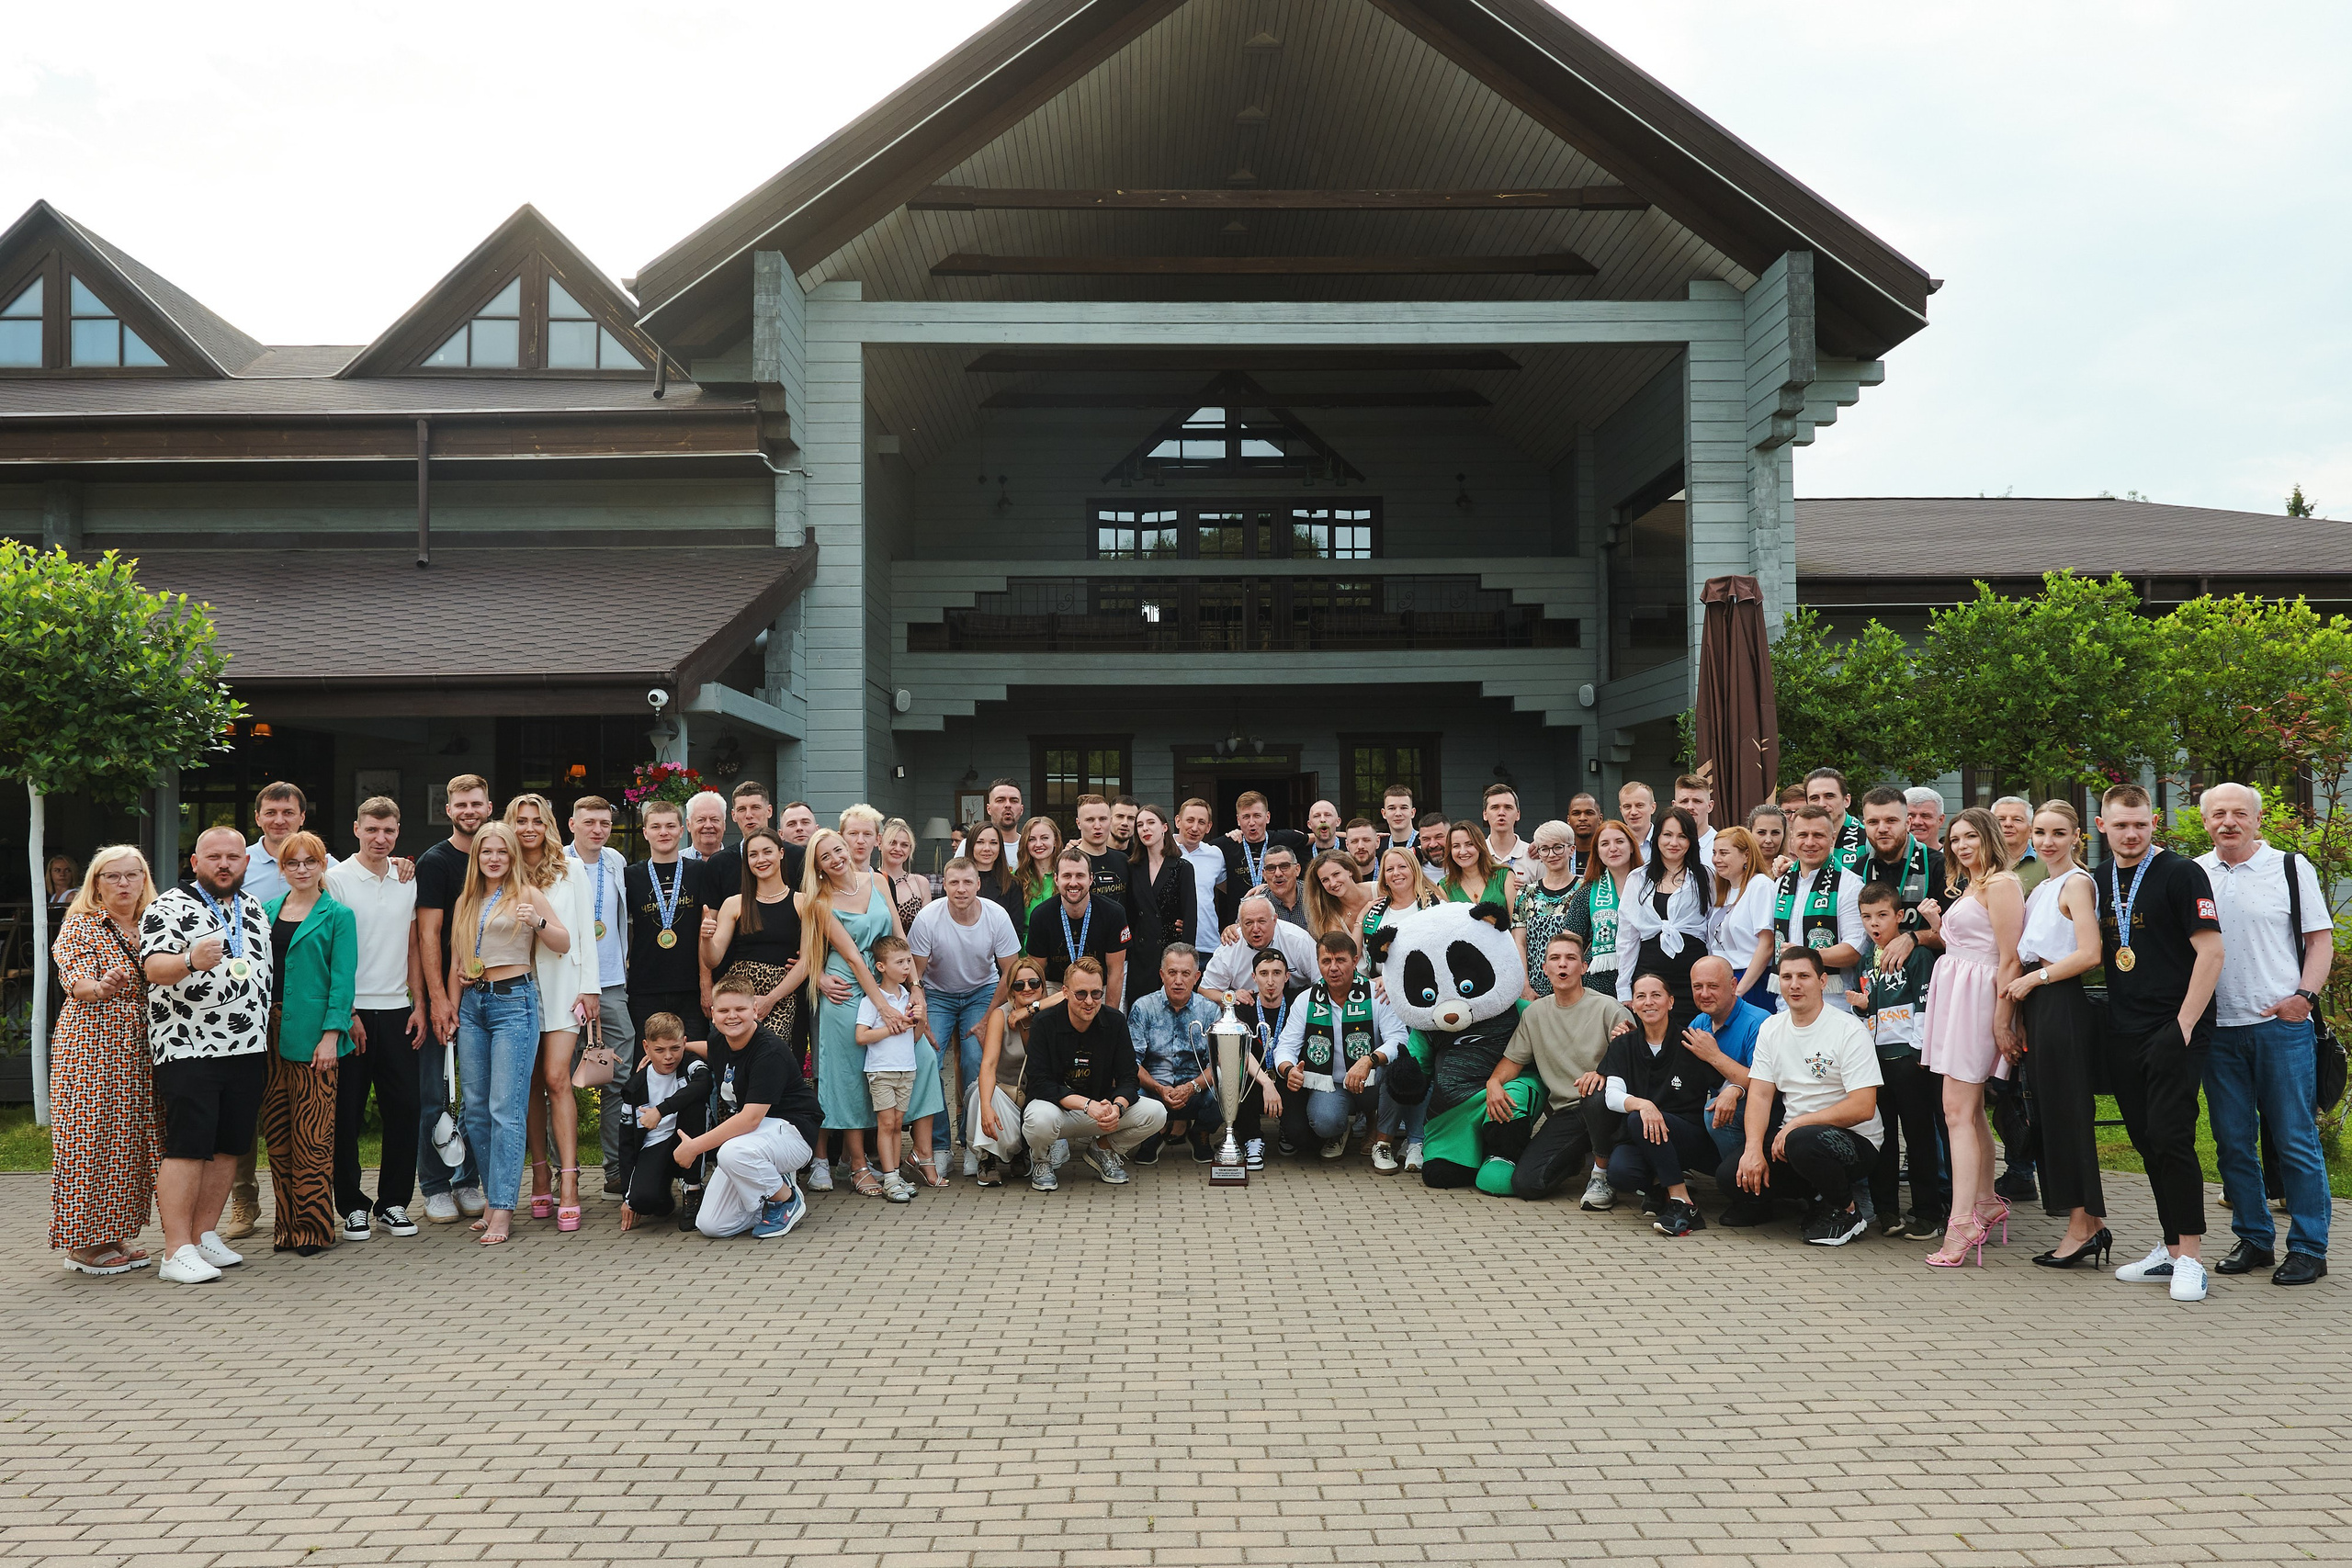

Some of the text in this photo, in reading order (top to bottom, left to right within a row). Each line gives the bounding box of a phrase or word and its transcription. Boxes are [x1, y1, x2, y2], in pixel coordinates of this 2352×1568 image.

[1092, 882, 1126, 894] ЕМПИОНЫ
[1313, 989, 1329, 1018] SA
[1347, 989, 1366, 1016] FC
